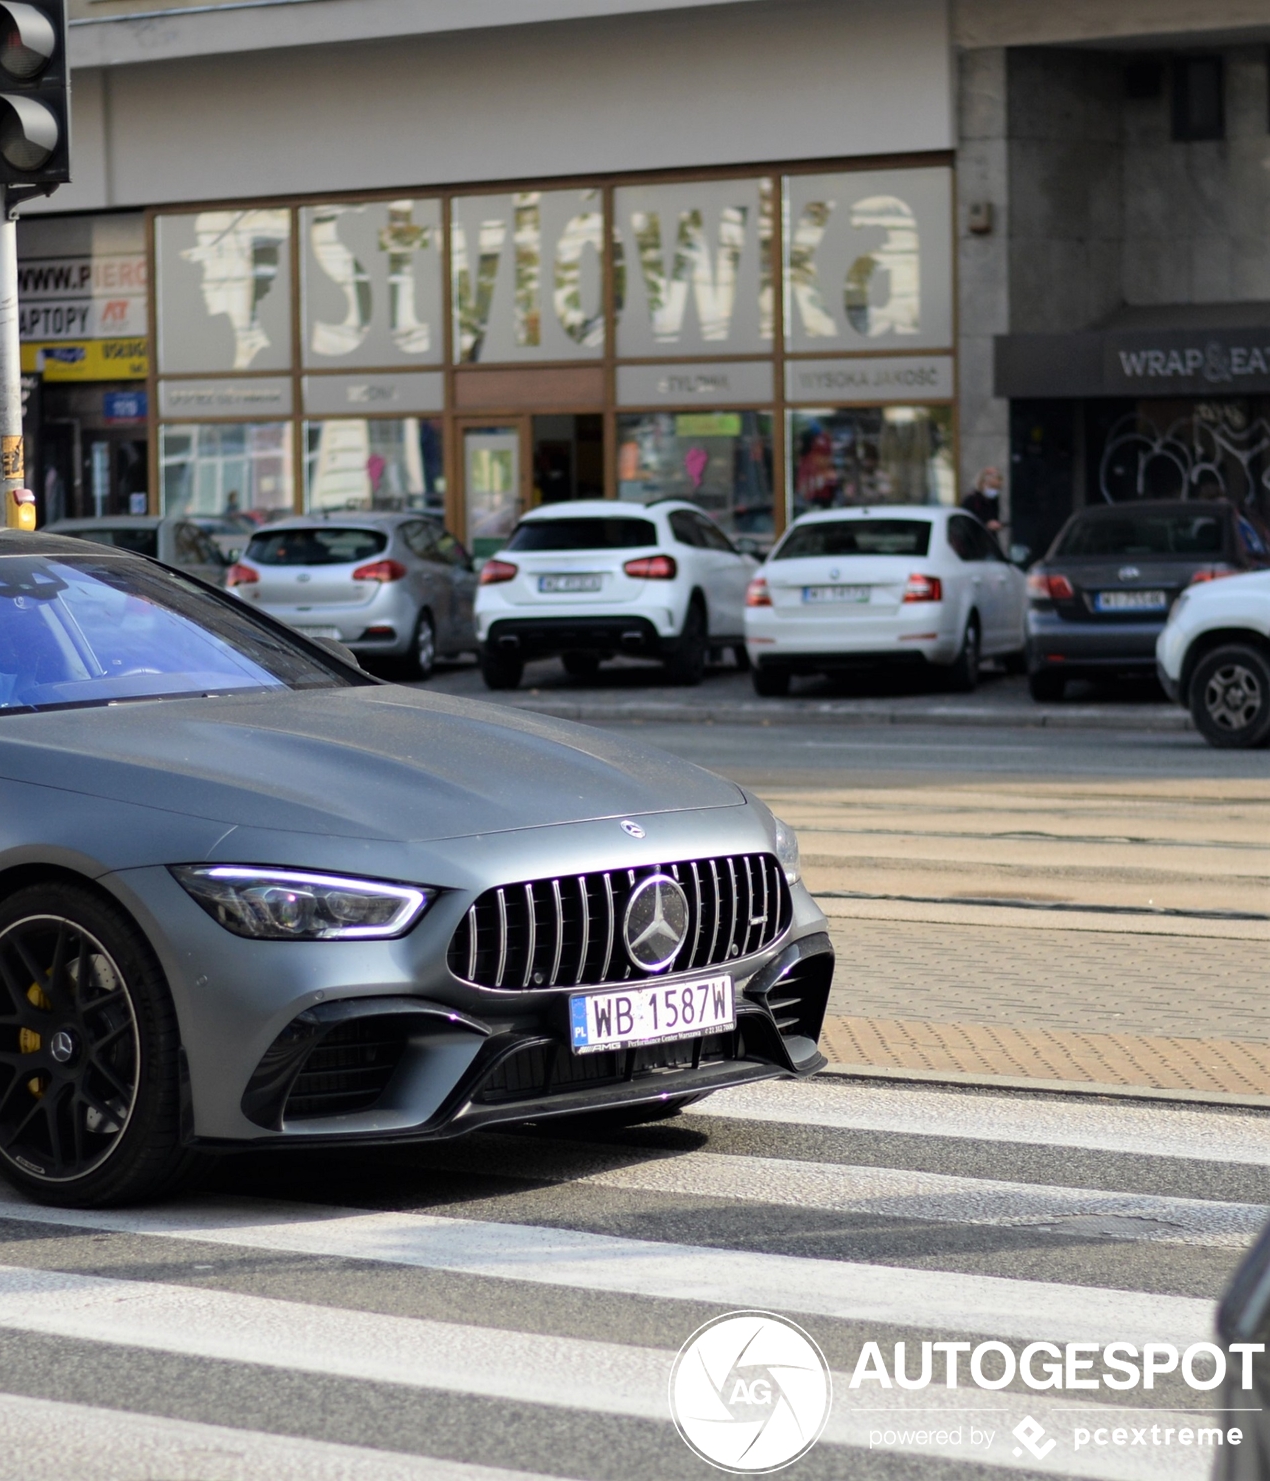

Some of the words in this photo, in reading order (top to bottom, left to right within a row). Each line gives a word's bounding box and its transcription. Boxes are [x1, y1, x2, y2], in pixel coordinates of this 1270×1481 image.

[19, 306, 89, 335] APTOPY
[799, 371, 868, 389] WYSOKA
[594, 997, 634, 1038] WB
[649, 981, 726, 1030] 1587W
[575, 1027, 587, 1039] PL
[628, 1036, 660, 1048] Performance
[661, 1034, 679, 1043] Center
